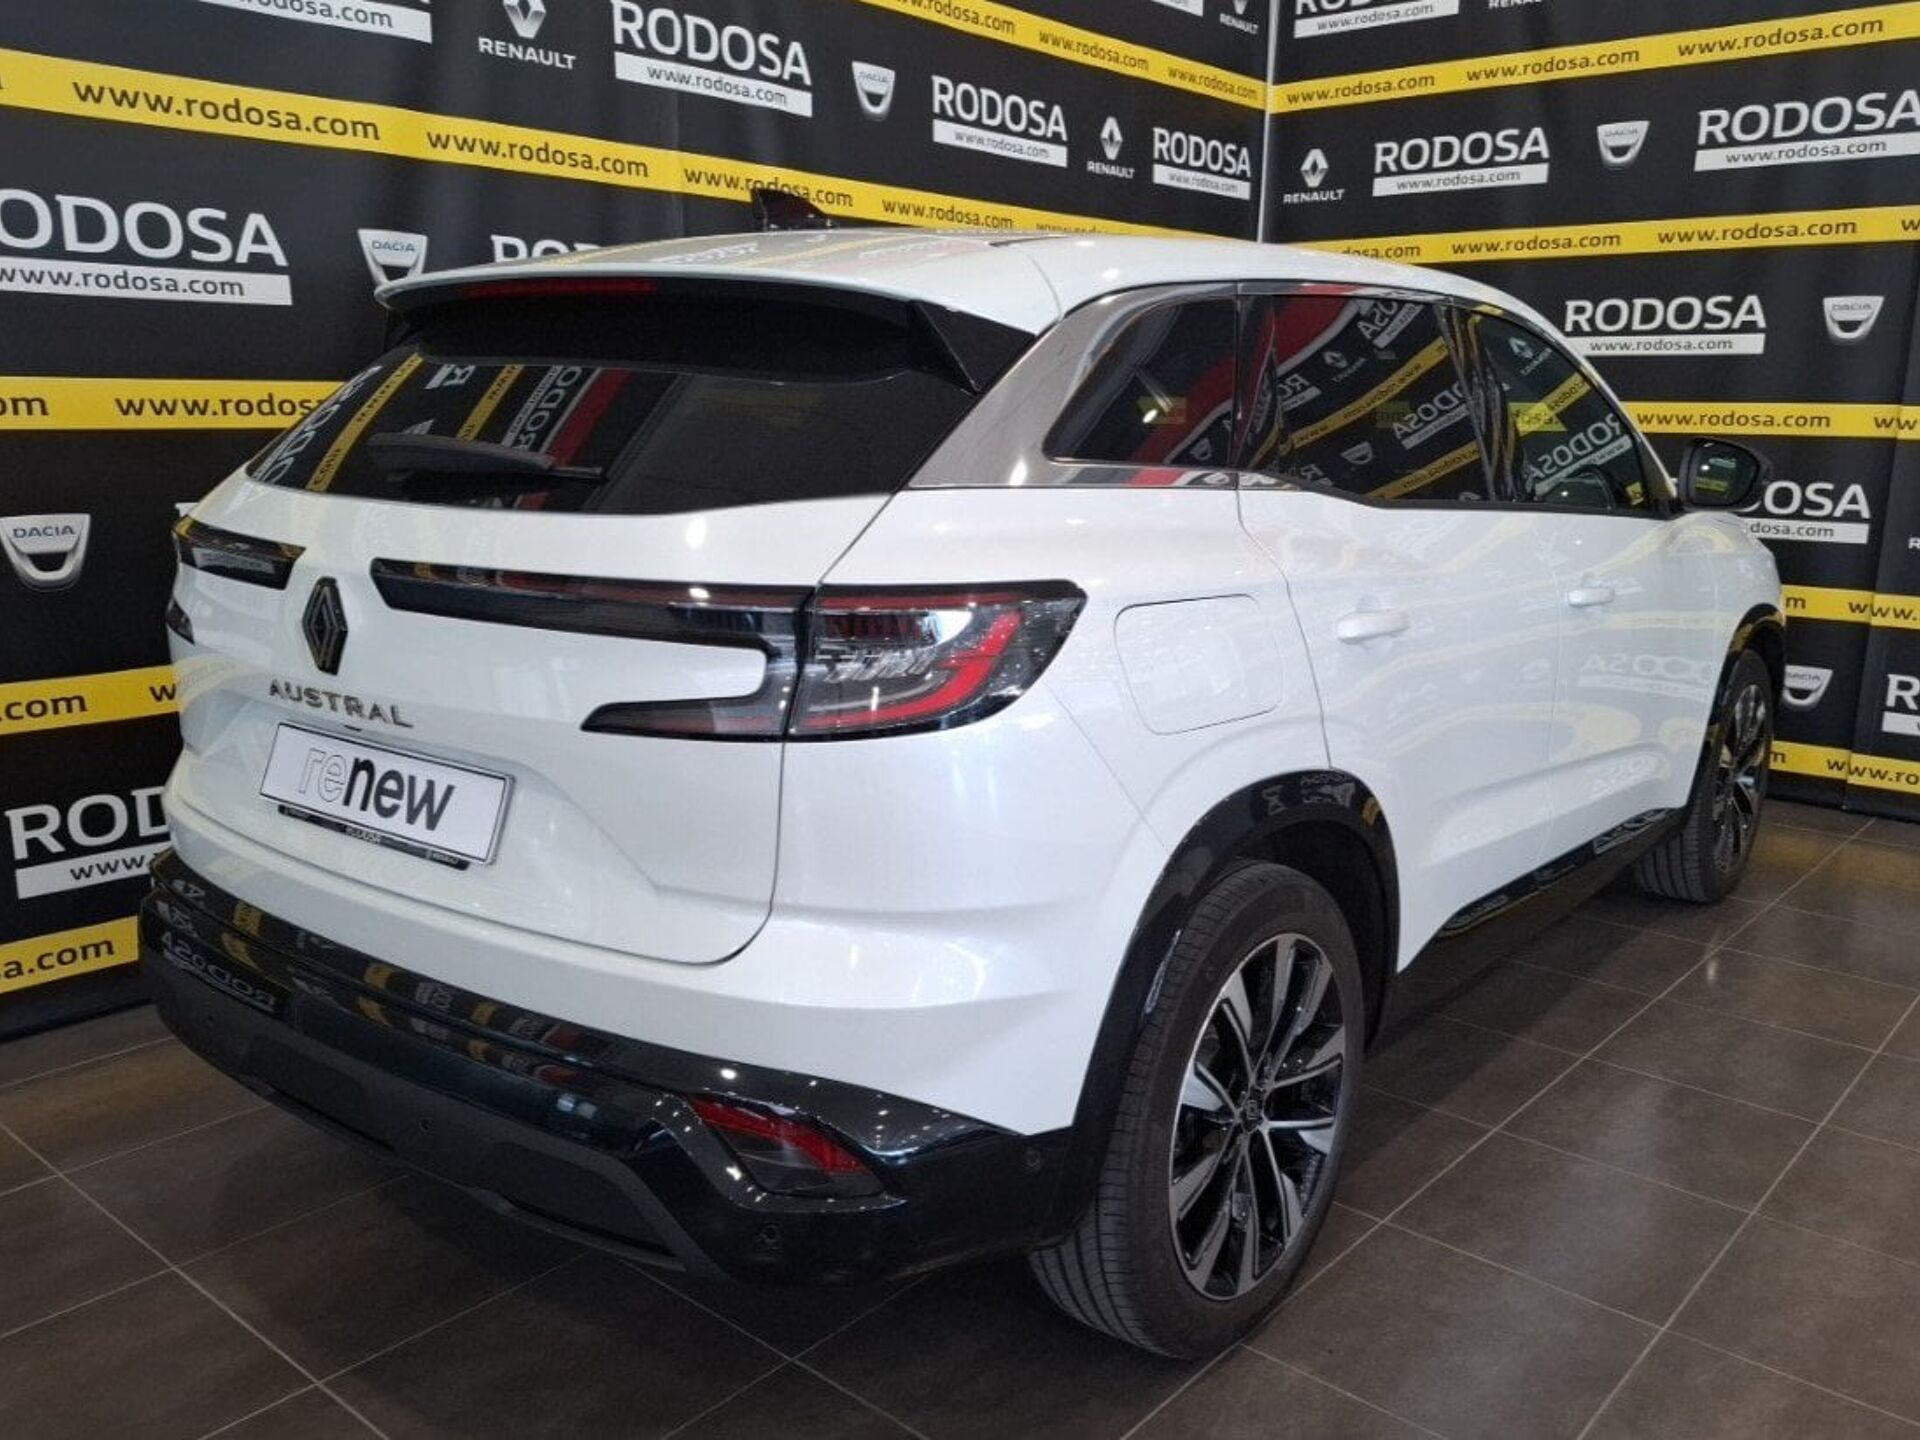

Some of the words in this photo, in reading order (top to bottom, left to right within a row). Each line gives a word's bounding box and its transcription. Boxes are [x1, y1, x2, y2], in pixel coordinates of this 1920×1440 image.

[1317, 4, 1435, 31] www.rodosa.com
[479, 37, 577, 70] RENAULT
[613, 0, 812, 86] RODOSA
[1039, 28, 1149, 71] www.rodosa.com
[1678, 18, 1883, 57] www.rodosa.com
[1467, 49, 1640, 82] www.rodosa.com
[648, 64, 788, 105] www.rodosa.com
[1167, 66, 1258, 99] www.rodosa.com
[1287, 74, 1435, 104] www.rodosa.com
[72, 80, 381, 141] www.rodosa.com
[931, 75, 1068, 142] RODOSA
[1698, 90, 1920, 146] RODOSA
[427, 131, 649, 178] www.rodosa.com
[955, 128, 1050, 158] www.rodosa.com
[1152, 127, 1251, 177] RODOSA
[1374, 127, 1550, 174] RODOSA
[1726, 140, 1887, 163] www.rodosa.com
[1087, 161, 1134, 179] RENAULT
[1397, 169, 1521, 191] www.rodosa.com
[1283, 189, 1345, 204] RENAULT
[0, 188, 289, 266] ODOSA
[882, 198, 1014, 229] www.rodosa.com
[372, 240, 416, 254] DACIA
[1452, 234, 1621, 255] www.rodosa.com
[1658, 219, 1857, 244] www.rodosa.com
[1564, 295, 1767, 333] RODOSA
[1832, 303, 1872, 311] DACIA
[1590, 338, 1733, 352] www.rodosa.com
[115, 392, 326, 417] www.rodos
[1637, 410, 1831, 428] www.rodosa.com
[1745, 481, 1871, 519] OSA
[13, 525, 77, 539] DACIA
[269, 679, 414, 728] AUSTRAL
[299, 747, 456, 832] renew
